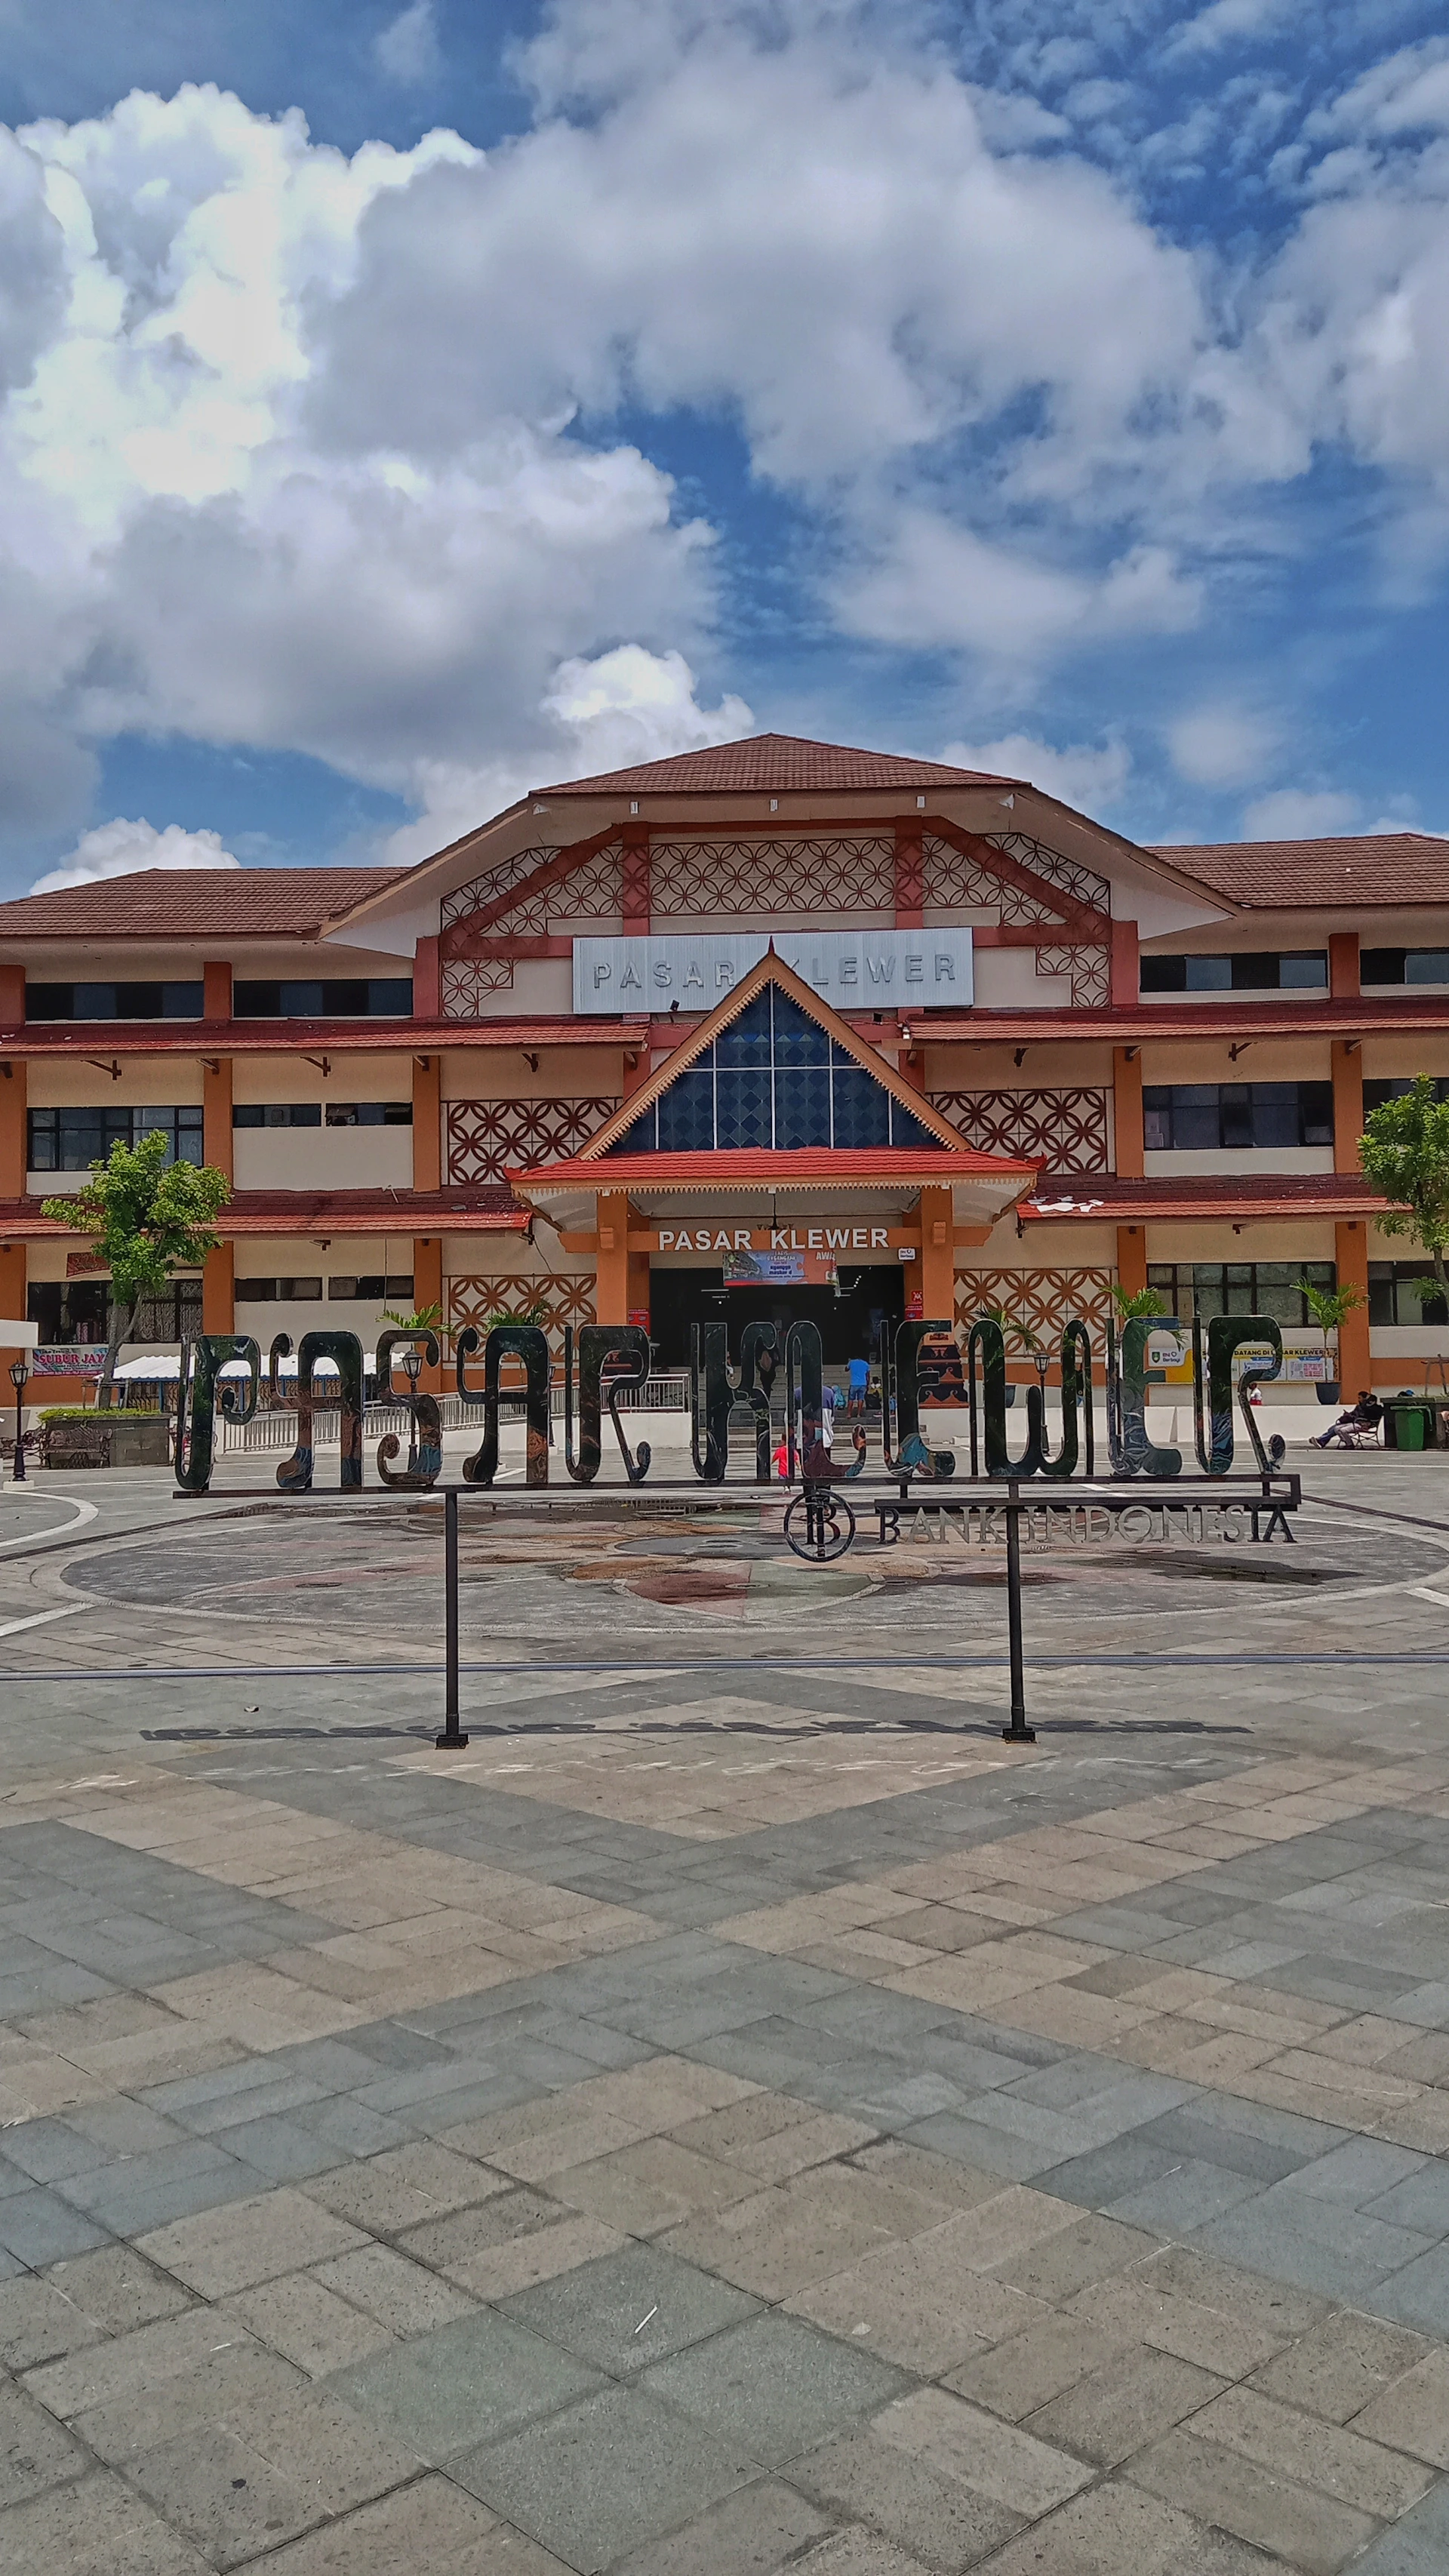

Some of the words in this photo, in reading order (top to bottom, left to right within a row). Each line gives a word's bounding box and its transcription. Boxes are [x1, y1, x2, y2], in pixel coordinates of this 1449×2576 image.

[592, 959, 737, 989] PASAR
[790, 953, 956, 985] LEWER
[659, 1230, 752, 1251] PASAR
[771, 1227, 889, 1249] KLEWER
[38, 1353, 80, 1365] SUBUR
[82, 1353, 106, 1364] JAY
[175, 1325, 651, 1490] PASAR
[690, 1314, 1286, 1479] KLEWER
[876, 1505, 1009, 1544] BANK
[1026, 1503, 1298, 1544] INDONESIA
